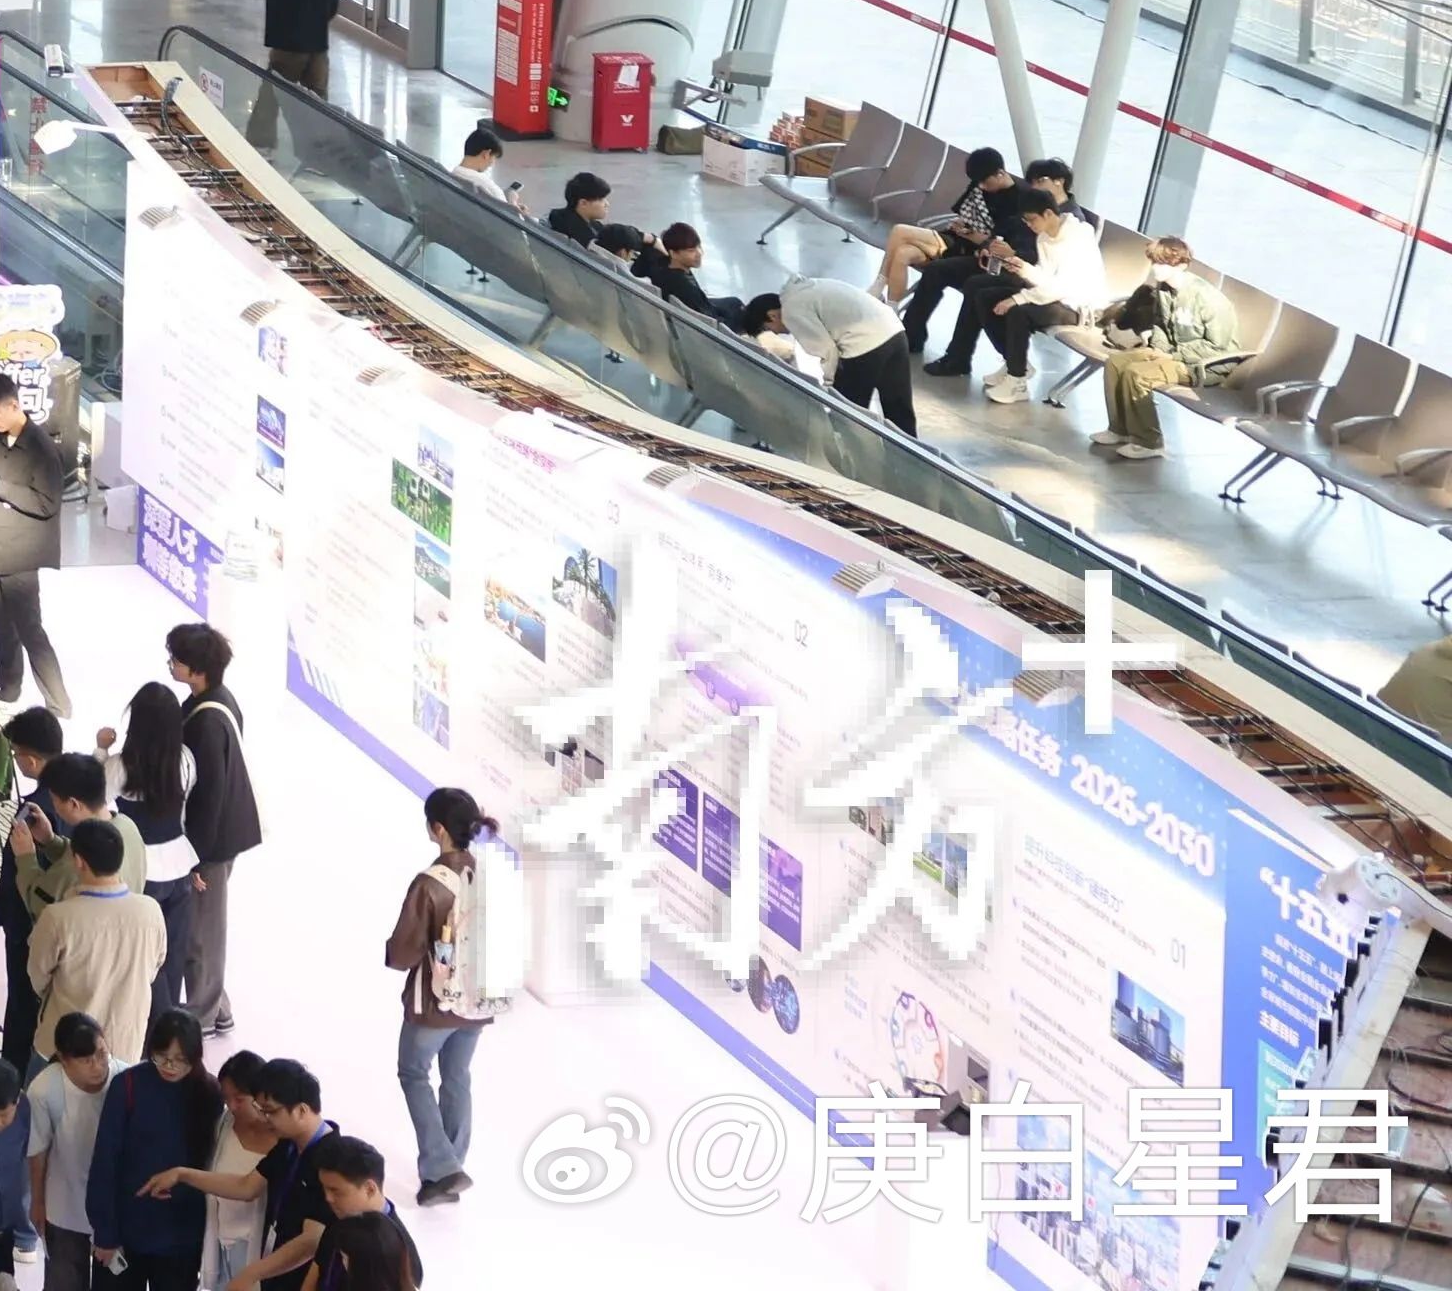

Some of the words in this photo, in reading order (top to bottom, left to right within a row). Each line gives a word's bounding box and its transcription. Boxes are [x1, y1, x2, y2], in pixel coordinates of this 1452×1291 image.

[793, 620, 809, 647] 02
[1070, 752, 1216, 876] 2026-2030
[1170, 938, 1187, 971] 01
